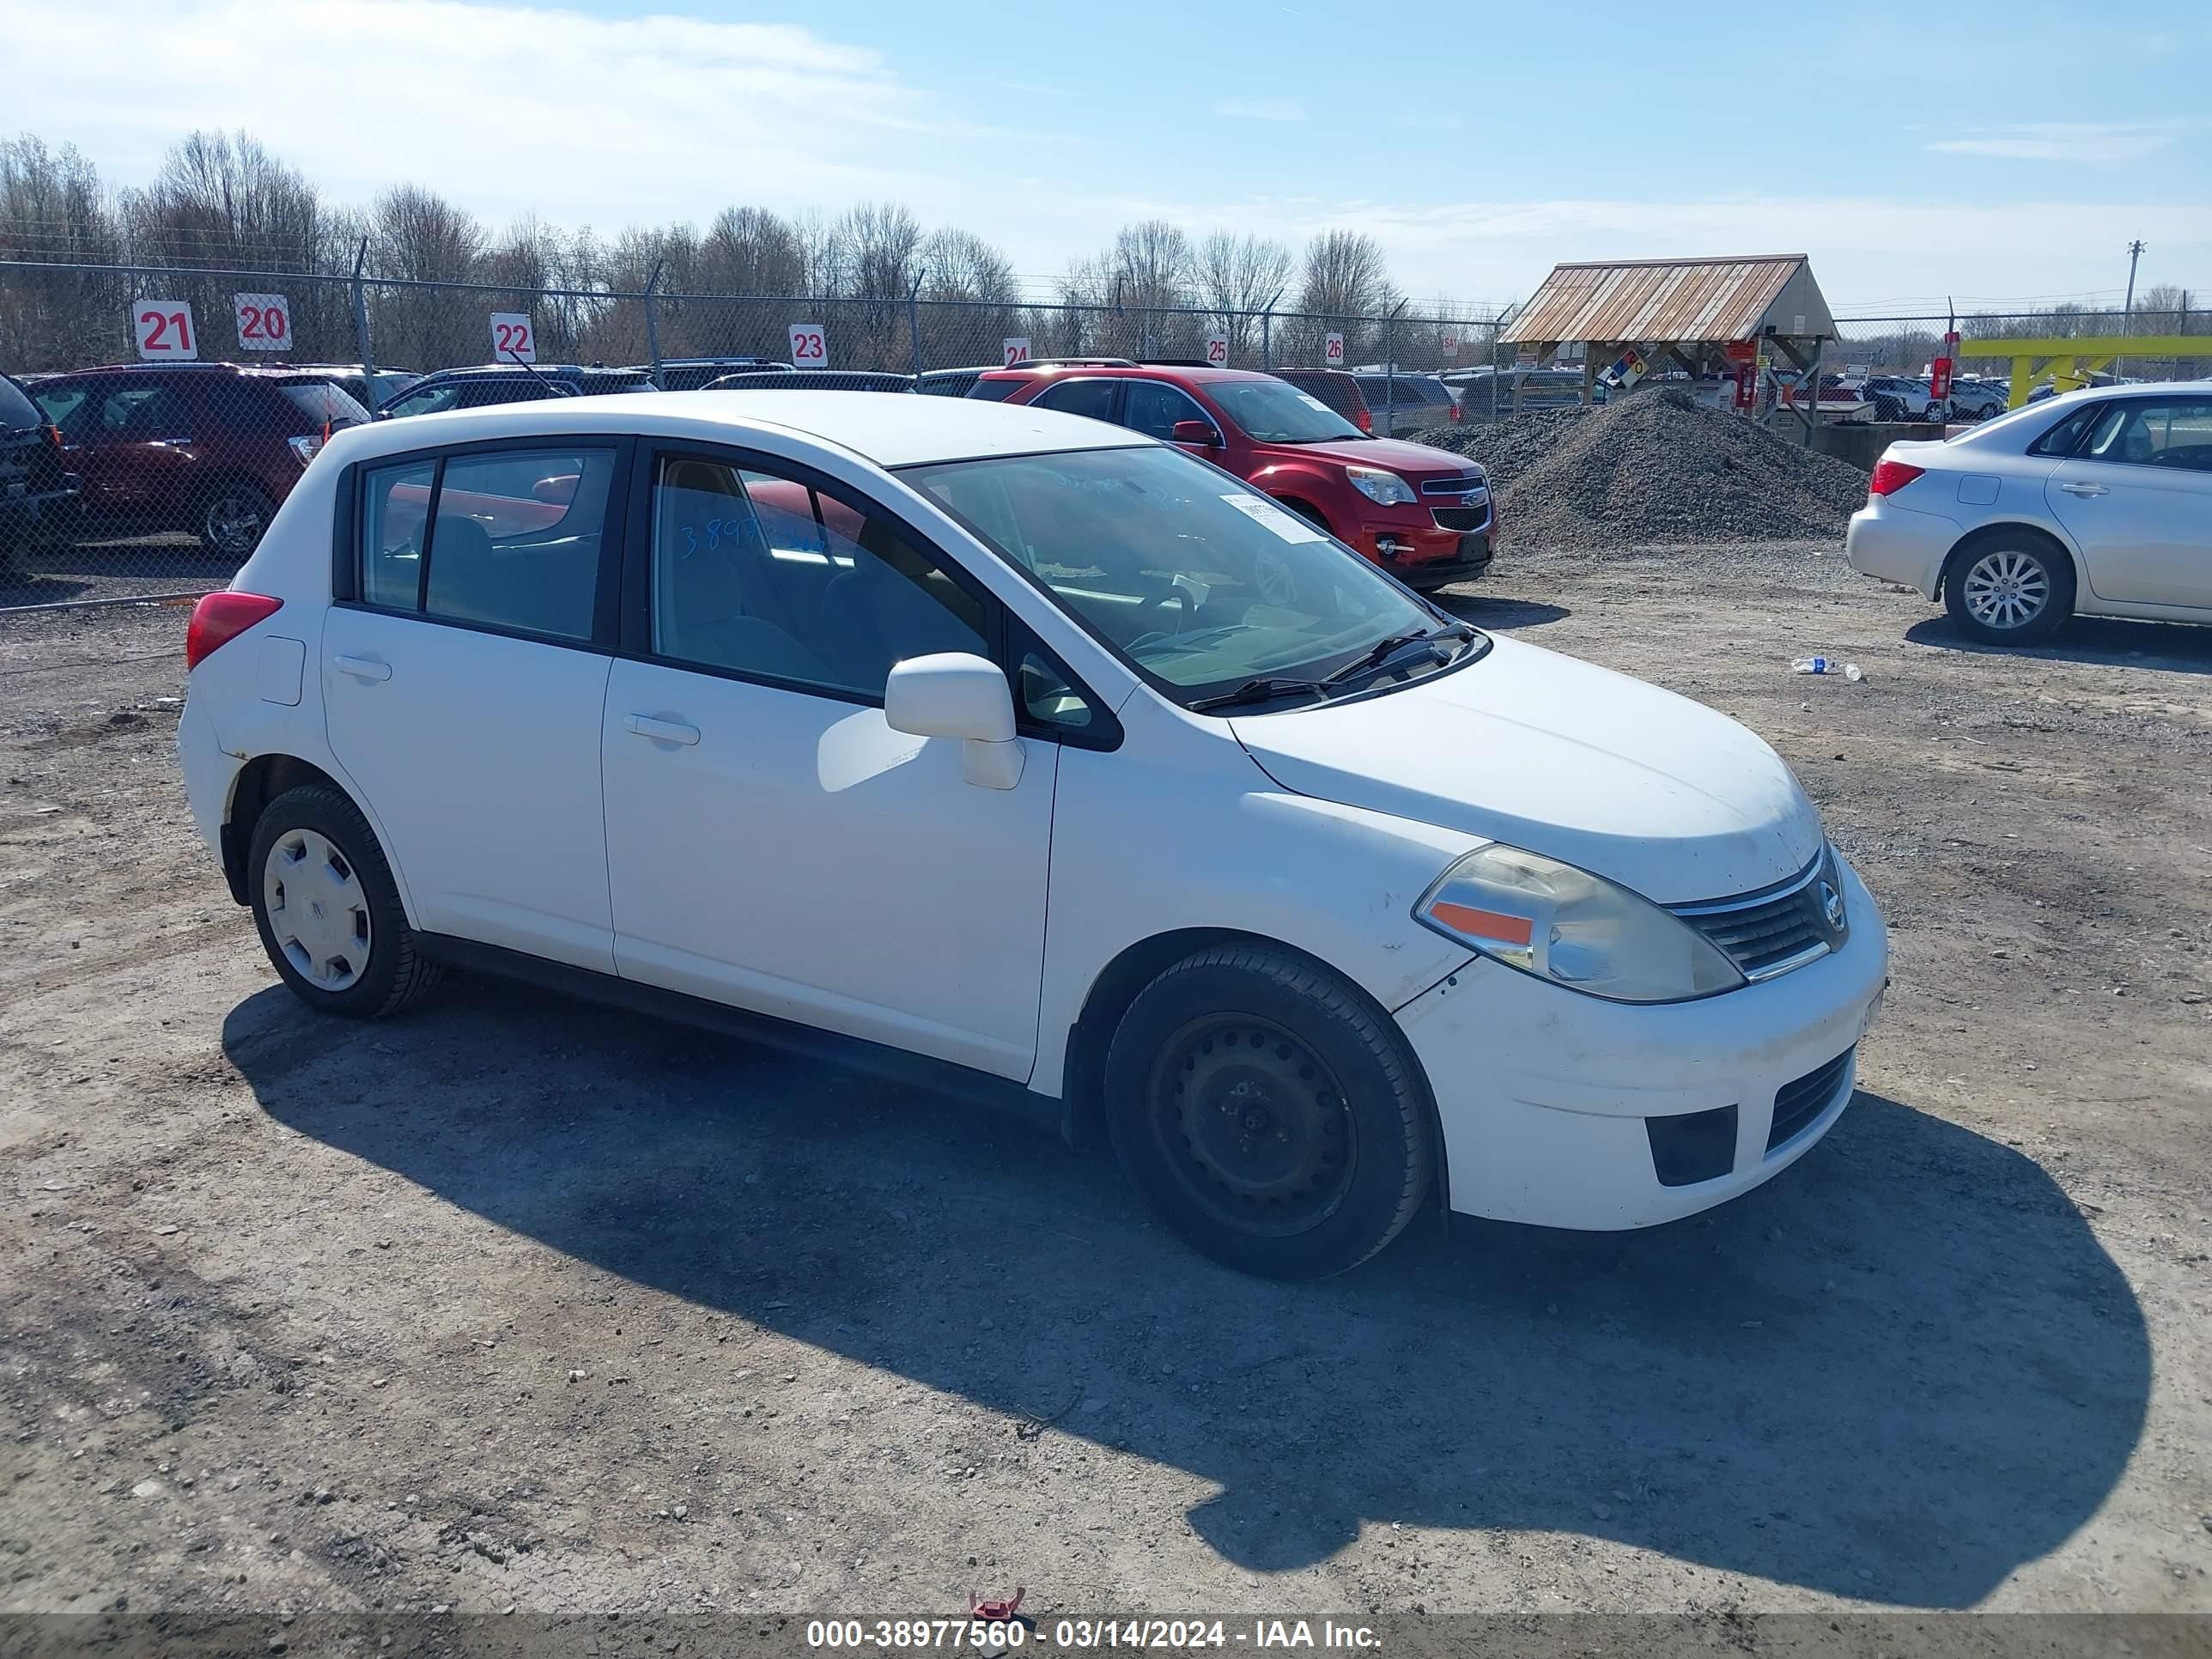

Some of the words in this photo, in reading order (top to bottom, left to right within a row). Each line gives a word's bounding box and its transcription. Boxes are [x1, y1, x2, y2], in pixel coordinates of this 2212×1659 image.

[141, 312, 190, 350] 21
[241, 307, 285, 339] 20
[496, 324, 531, 352] 22
[794, 333, 823, 358] 23
[1328, 339, 1341, 358] 26
[1007, 346, 1026, 365] 24
[1209, 341, 1225, 361] 25
[1635, 362, 1643, 374] 0
